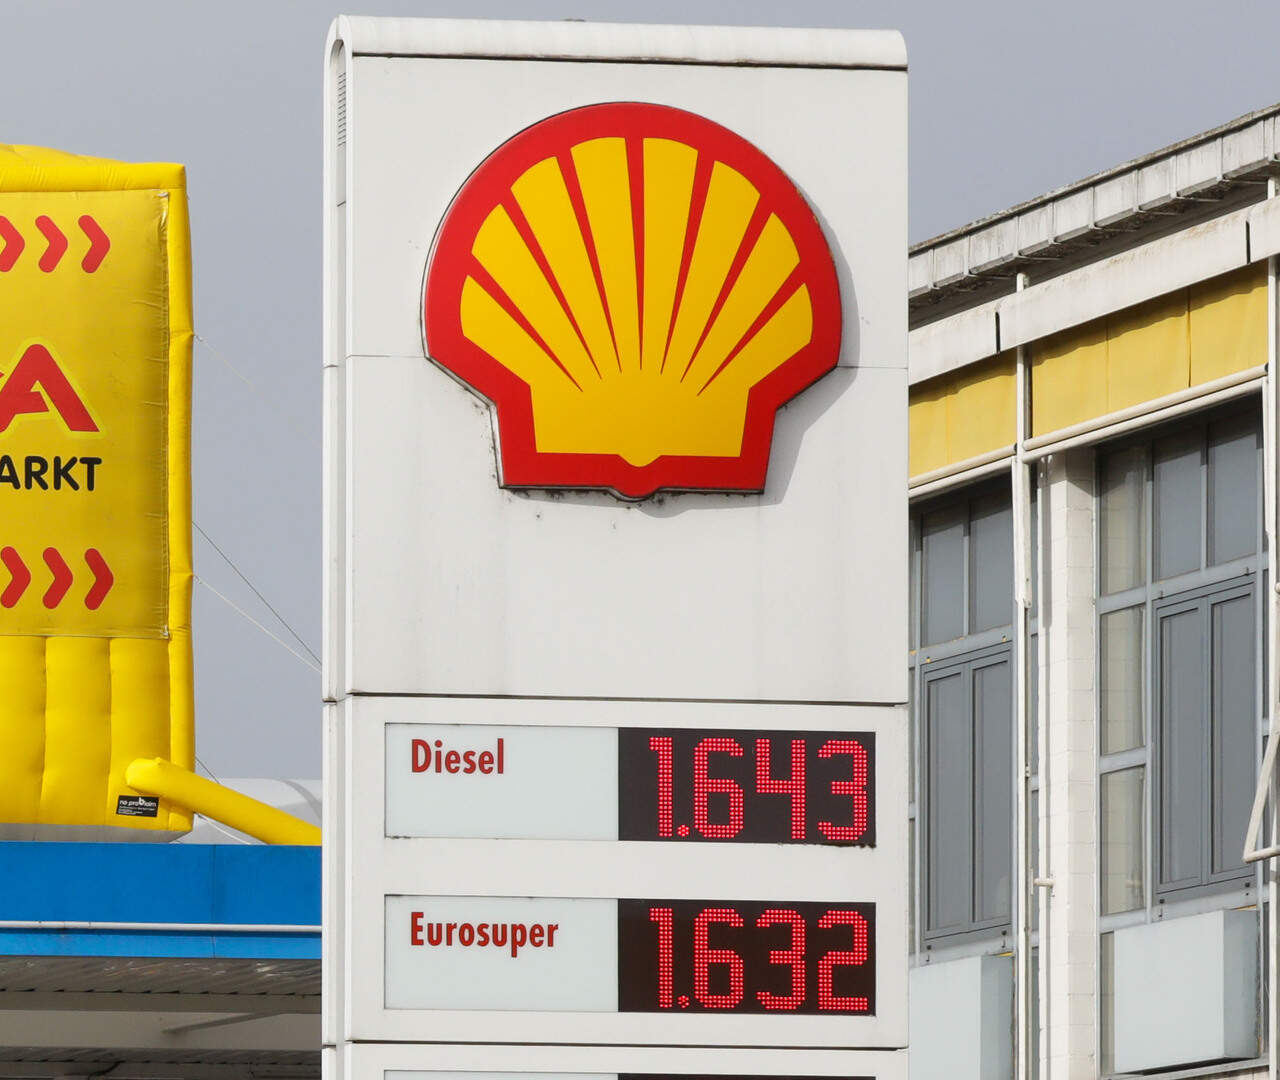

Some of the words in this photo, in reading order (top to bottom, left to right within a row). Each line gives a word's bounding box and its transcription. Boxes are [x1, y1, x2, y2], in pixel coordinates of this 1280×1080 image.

[410, 737, 505, 775] Diesel
[649, 736, 869, 841] 1.643
[410, 911, 559, 958] Eurosuper
[649, 906, 869, 1011] 1.632
